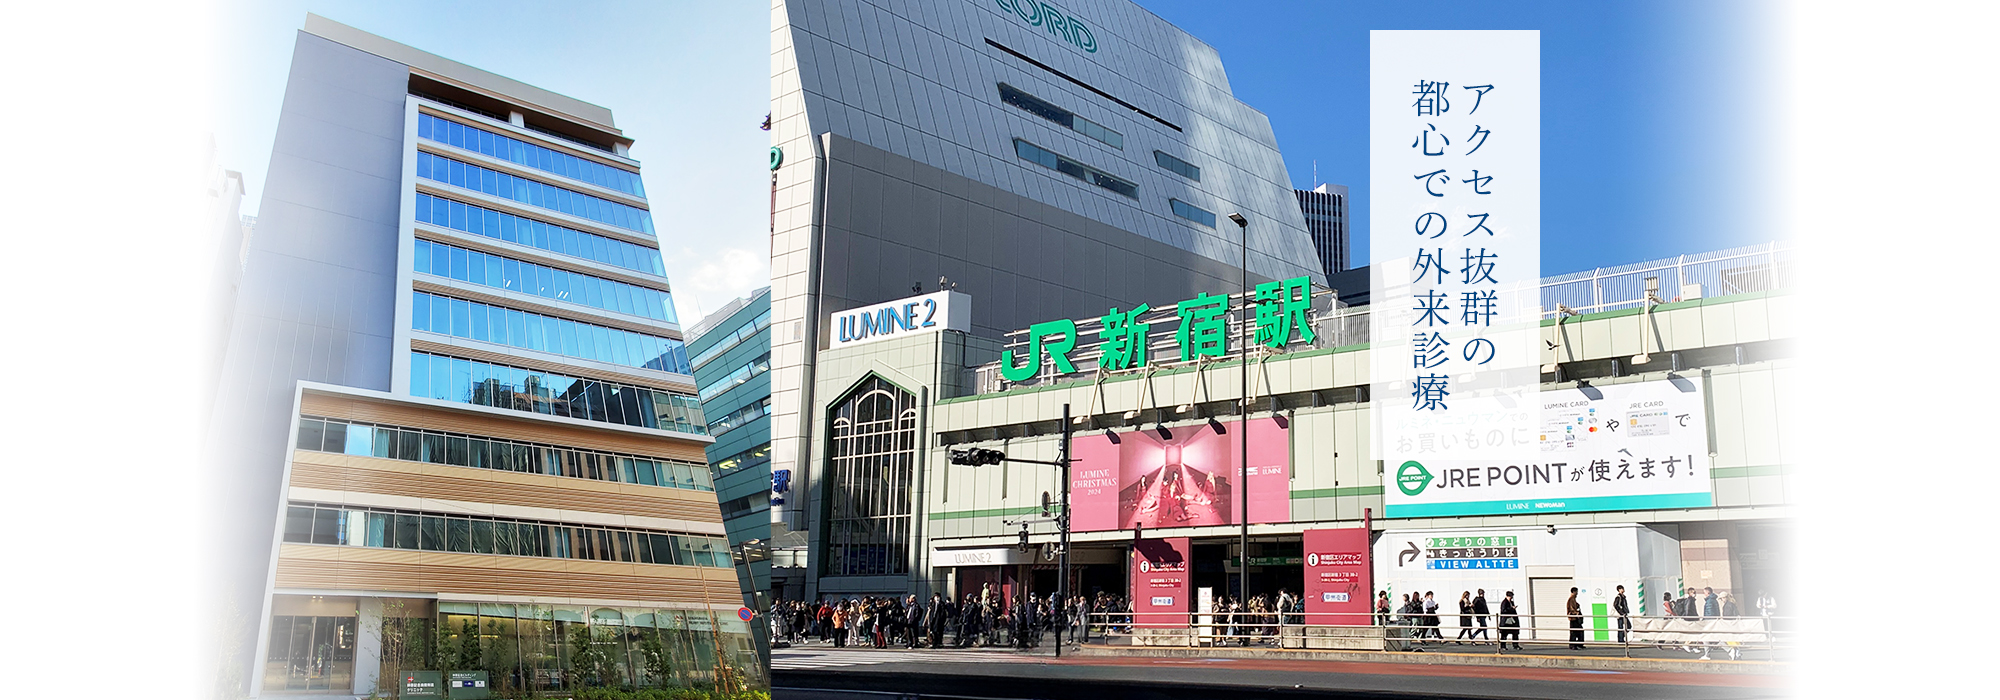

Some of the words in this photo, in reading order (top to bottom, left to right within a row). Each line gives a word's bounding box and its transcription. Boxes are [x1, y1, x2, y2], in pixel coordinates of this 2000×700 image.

[839, 302, 919, 343] LUMINE
[921, 298, 937, 329] 2
[1000, 275, 1317, 382] JR新宿駅
[1544, 402, 1569, 410] LUMINE
[1570, 400, 1589, 408] CARD
[1643, 400, 1664, 408] CARD
[1606, 418, 1620, 433] や
[1675, 413, 1691, 427] で
[1396, 427, 1530, 454] お買いものに
[1080, 469, 1110, 479] LUMINE
[1436, 467, 1481, 489] JRE
[1072, 478, 1117, 489] CHRISTMAS
[1088, 488, 1101, 496] 2024
[1506, 502, 1530, 510] LUMINE
[1438, 536, 1514, 547] みどりの窓口
[955, 552, 986, 564] LUMINE
[986, 552, 992, 563] 2
[1439, 547, 1515, 558] きっぷうりば
[1440, 560, 1470, 569] VIEW
[1475, 559, 1515, 568] ALTTE
